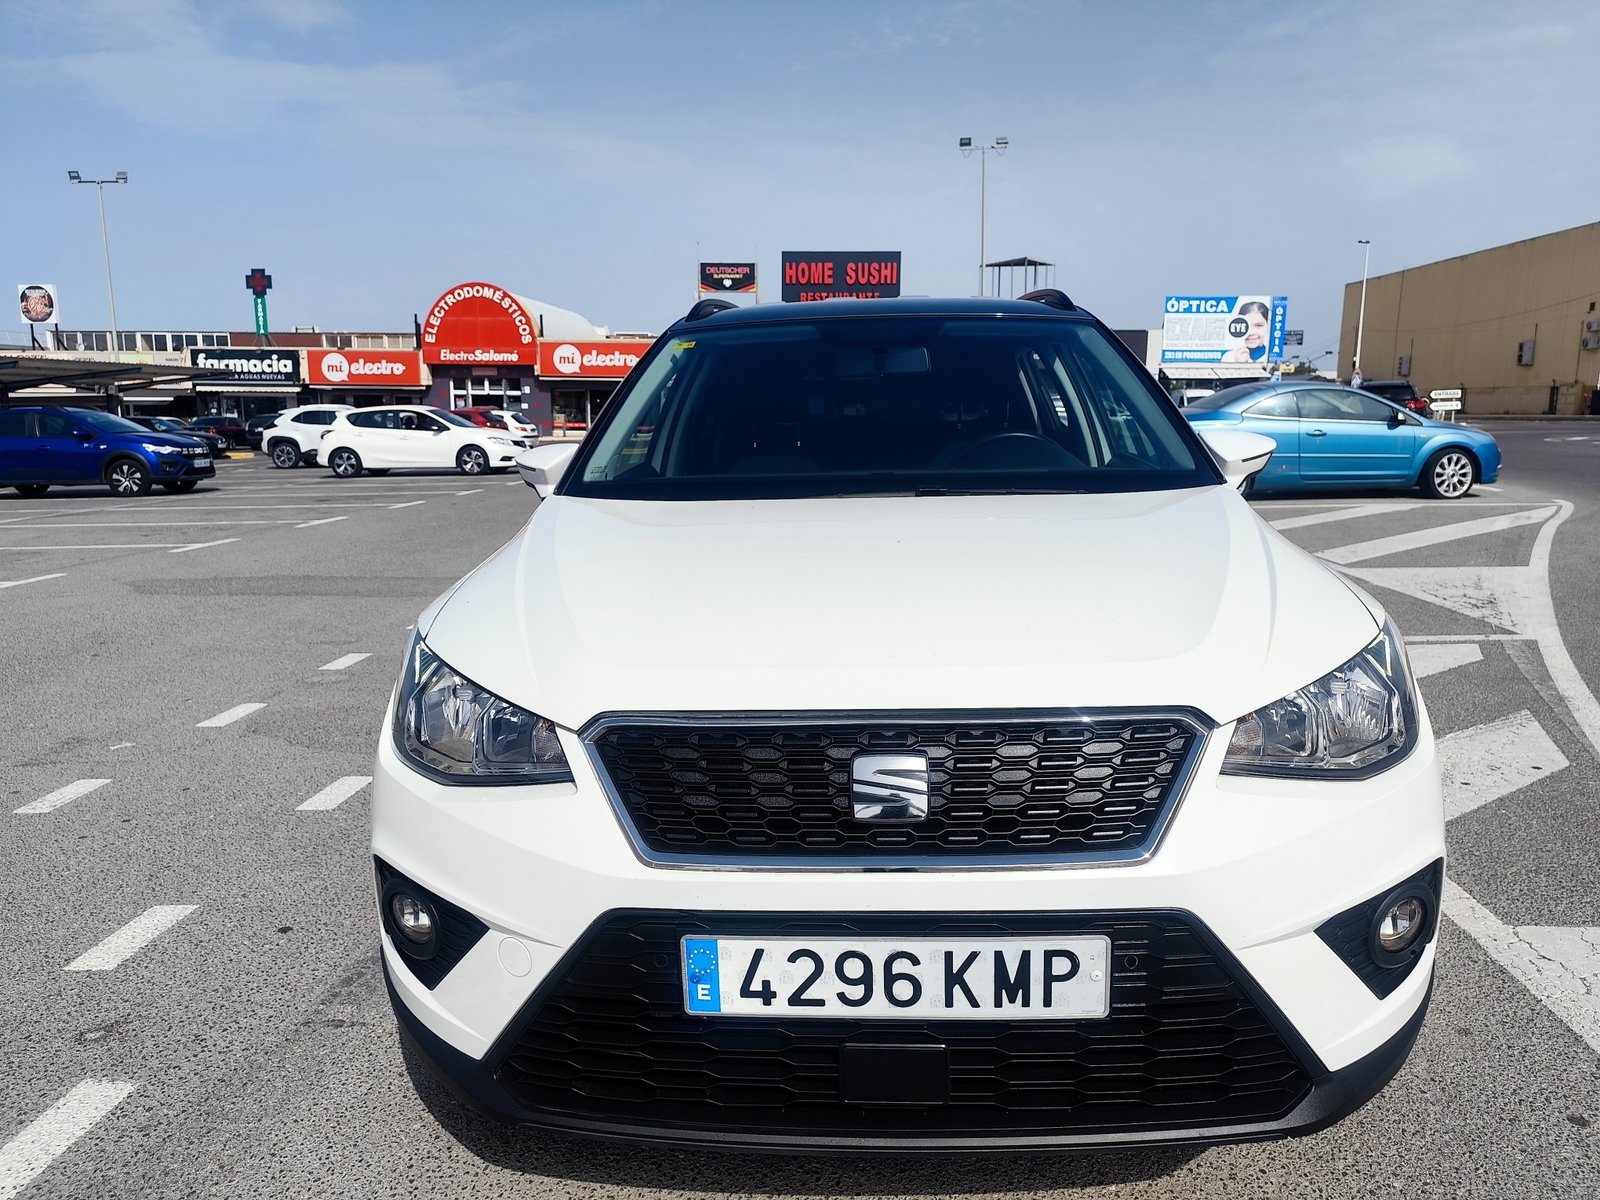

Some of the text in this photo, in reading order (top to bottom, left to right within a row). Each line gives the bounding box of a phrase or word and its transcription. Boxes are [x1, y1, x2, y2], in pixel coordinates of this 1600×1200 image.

[785, 262, 898, 285] HOME SUSHI
[1166, 296, 1229, 312] ÓPTICA
[424, 286, 533, 345] ELECTRODOMÉSTICOS
[1230, 323, 1246, 333] EYE
[196, 353, 293, 373] farmacia
[327, 357, 404, 375] mi electro
[559, 350, 637, 367] mi electro
[739, 947, 1081, 1008] 4296 KMP
[697, 984, 711, 1001] E
